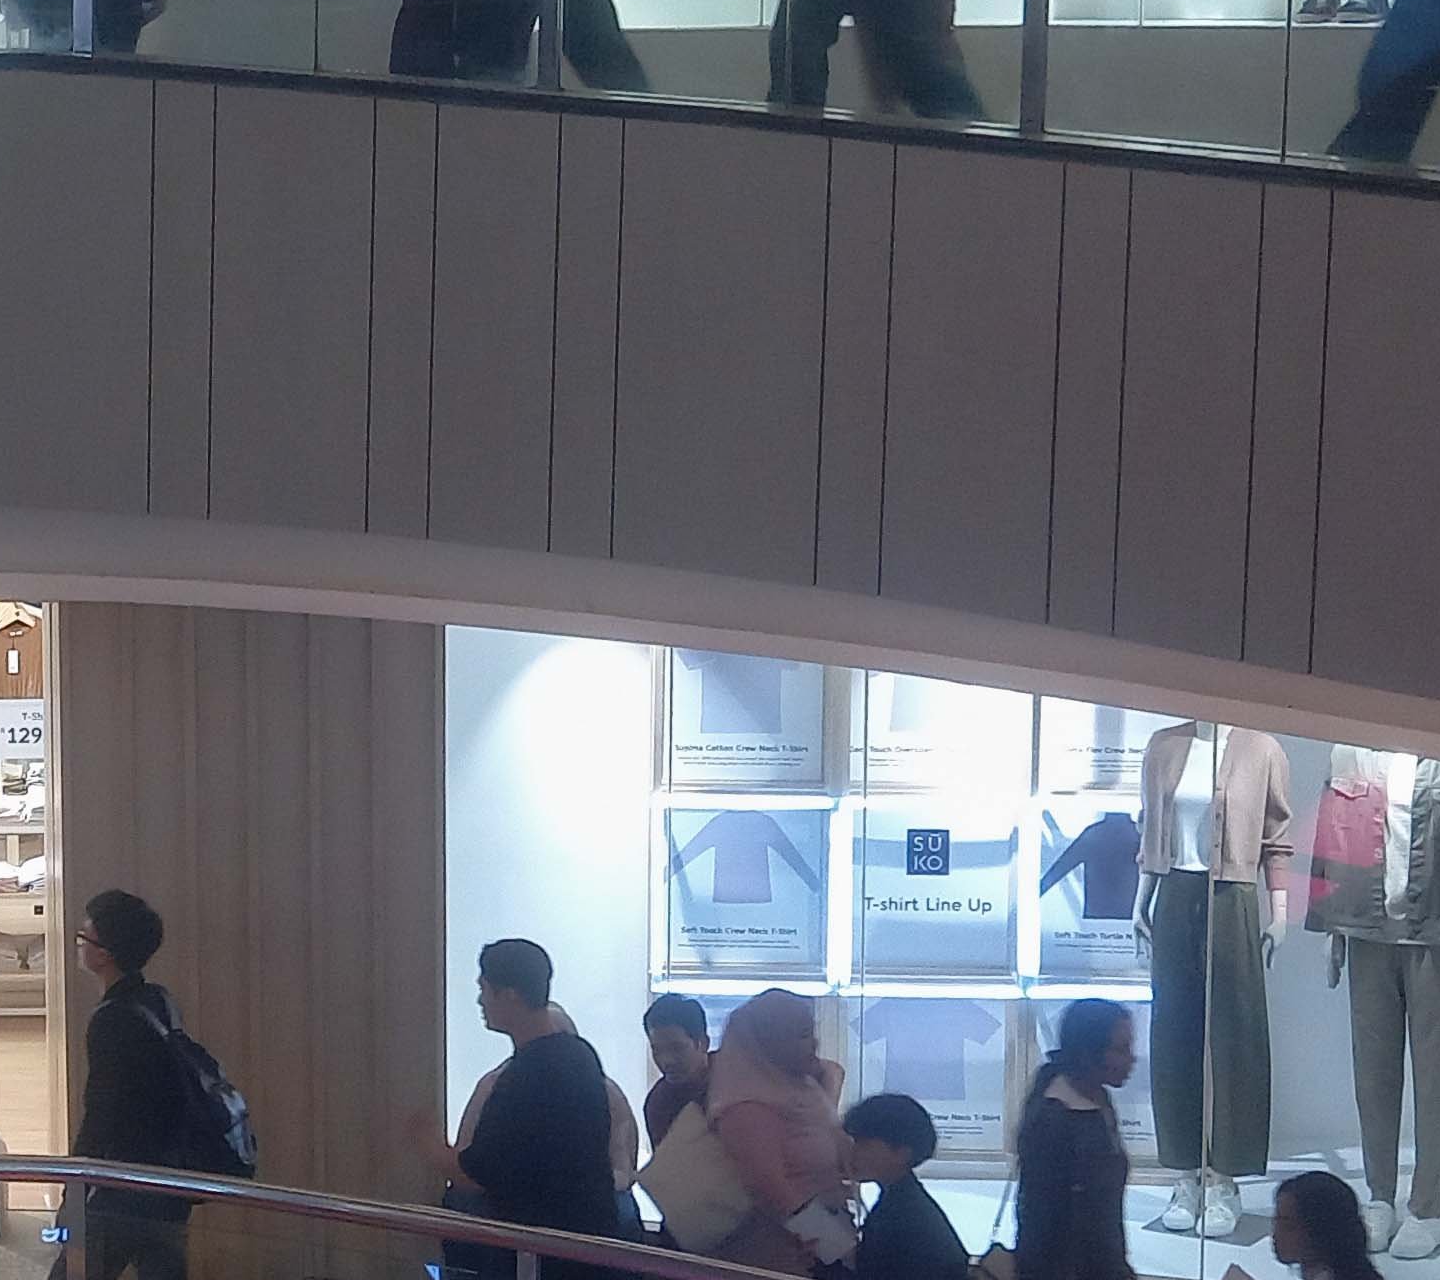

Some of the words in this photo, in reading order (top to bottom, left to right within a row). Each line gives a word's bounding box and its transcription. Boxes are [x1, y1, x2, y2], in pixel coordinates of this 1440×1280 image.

[913, 855, 943, 871] KO
[864, 897, 920, 911] T-shirt
[926, 897, 962, 912] Line
[968, 898, 992, 915] Up
